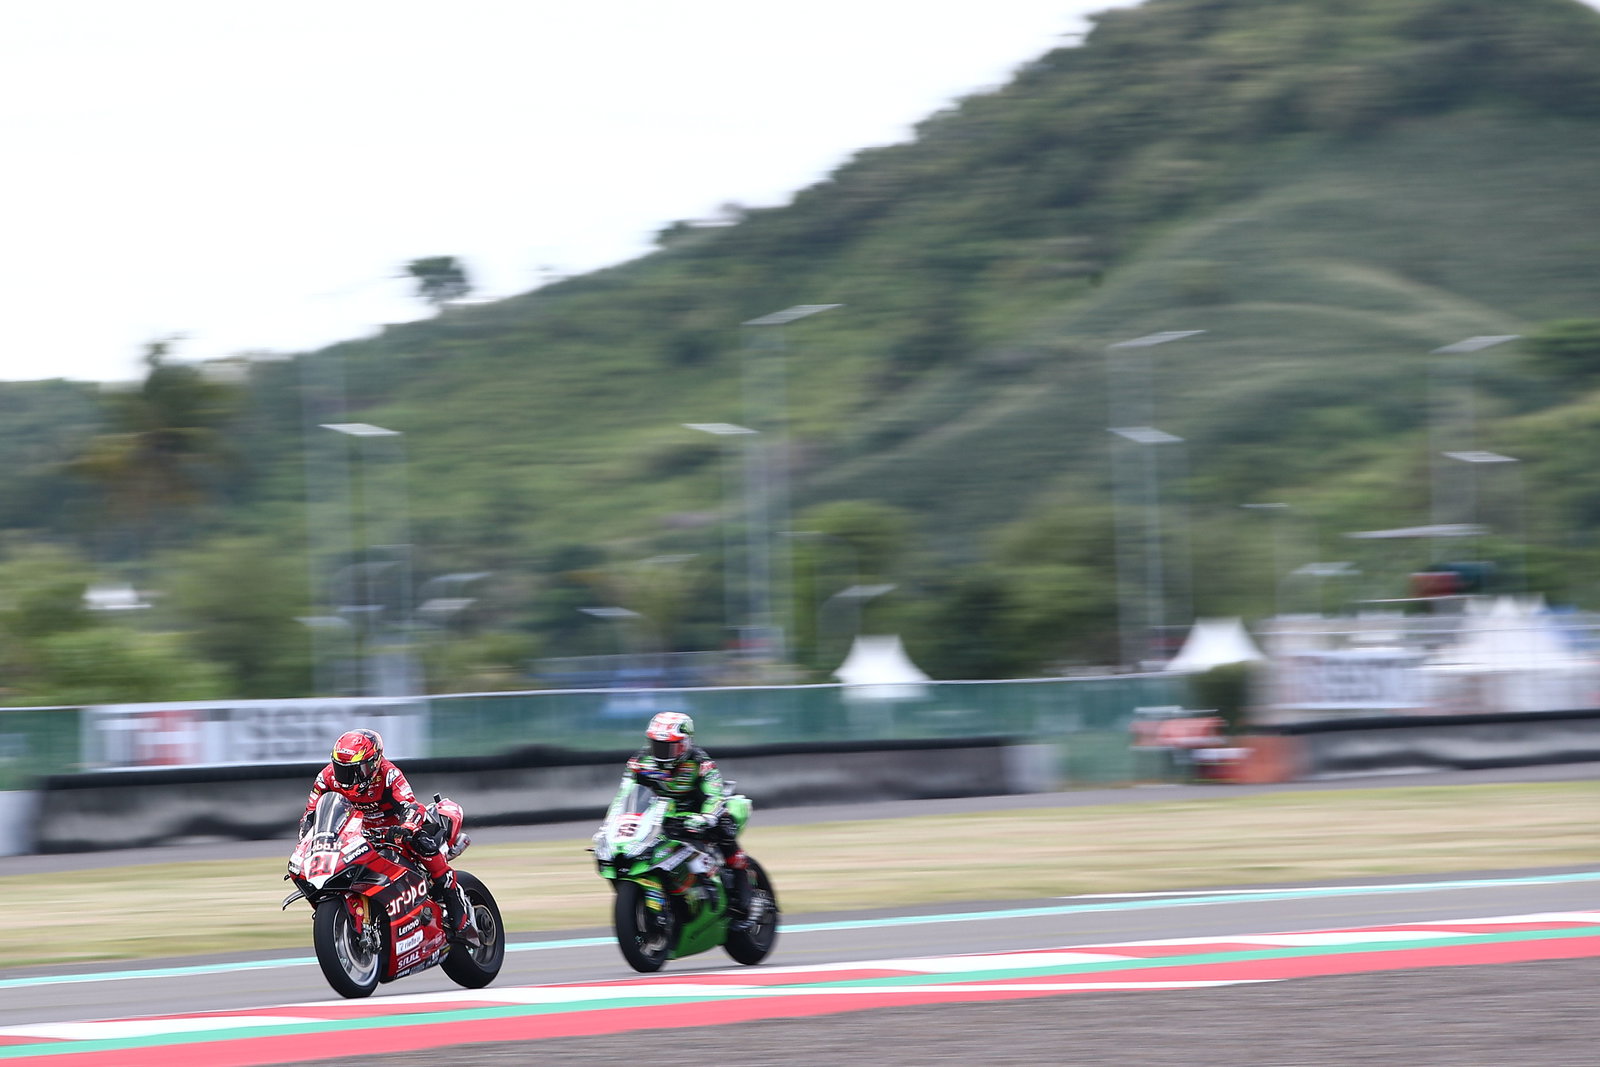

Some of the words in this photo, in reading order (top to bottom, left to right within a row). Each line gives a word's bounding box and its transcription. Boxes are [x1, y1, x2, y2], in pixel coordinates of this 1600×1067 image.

[342, 844, 369, 864] Lenovo
[308, 854, 333, 879] 21
[398, 918, 420, 937] Lenovo
